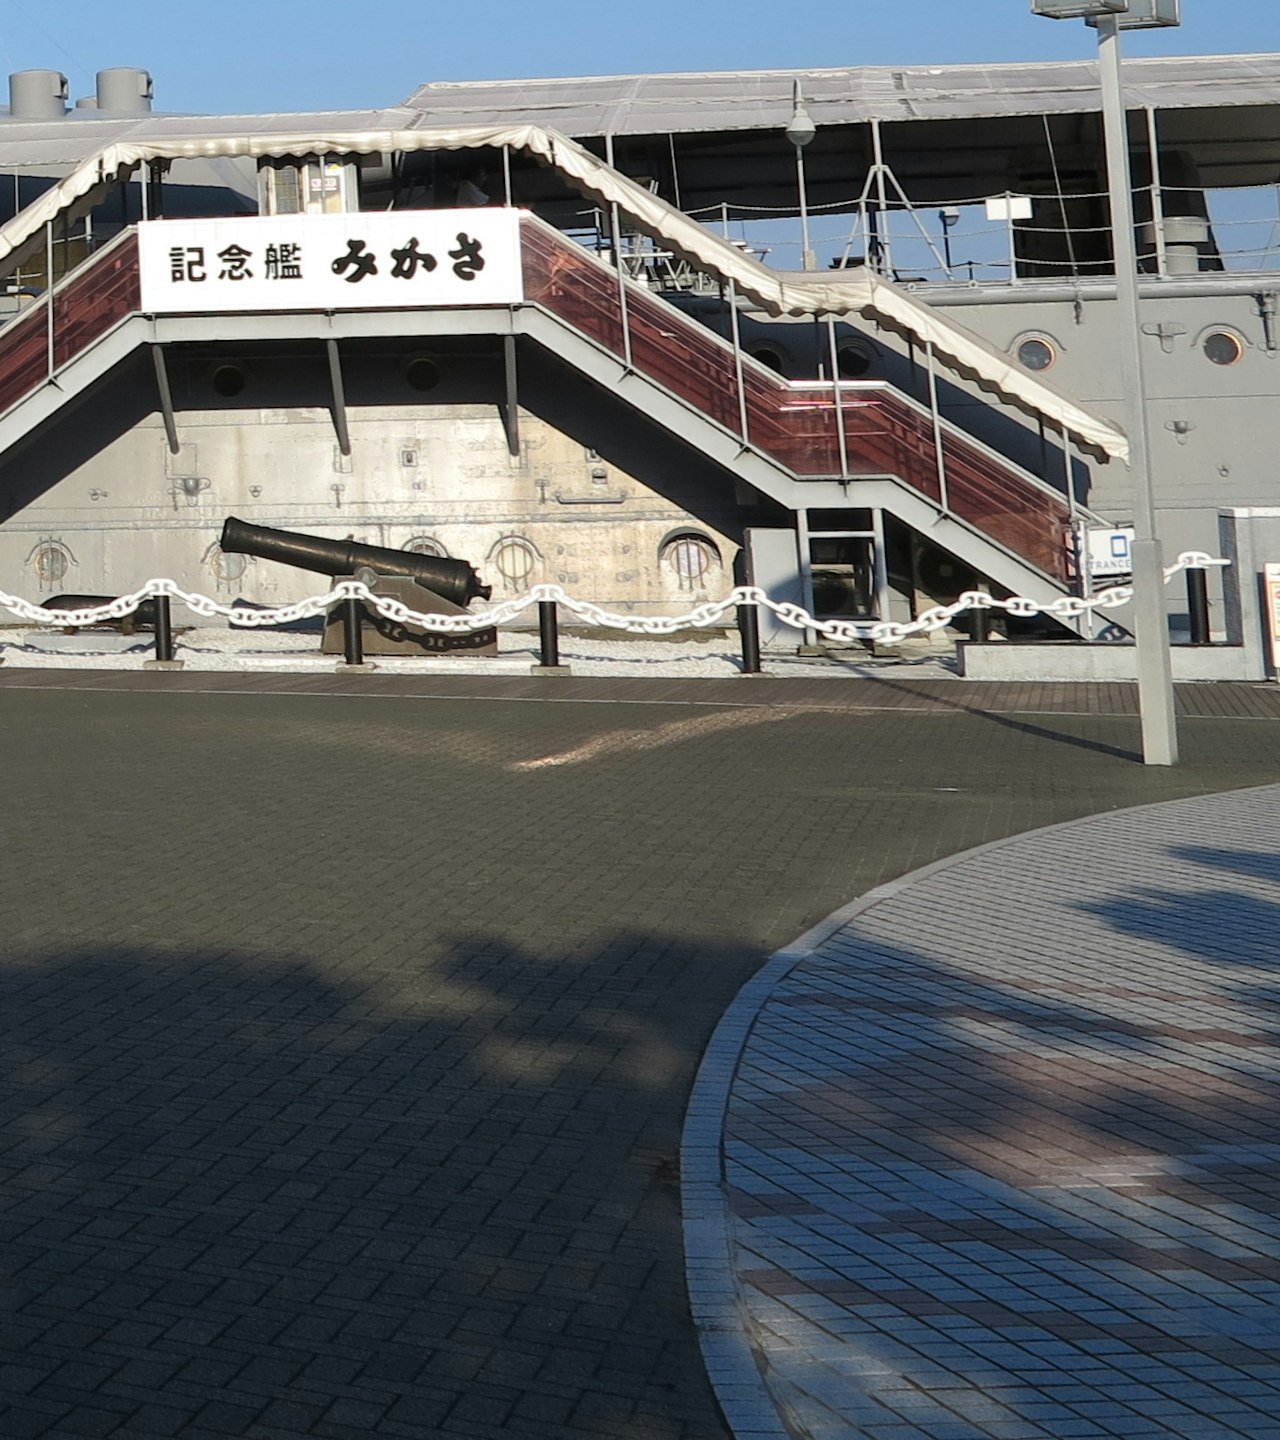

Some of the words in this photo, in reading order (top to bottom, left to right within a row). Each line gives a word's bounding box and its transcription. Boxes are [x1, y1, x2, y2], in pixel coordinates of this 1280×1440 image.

[168, 242, 303, 283] 記念艦
[331, 232, 486, 284] みかさ
[1080, 559, 1132, 571] TRANCE
